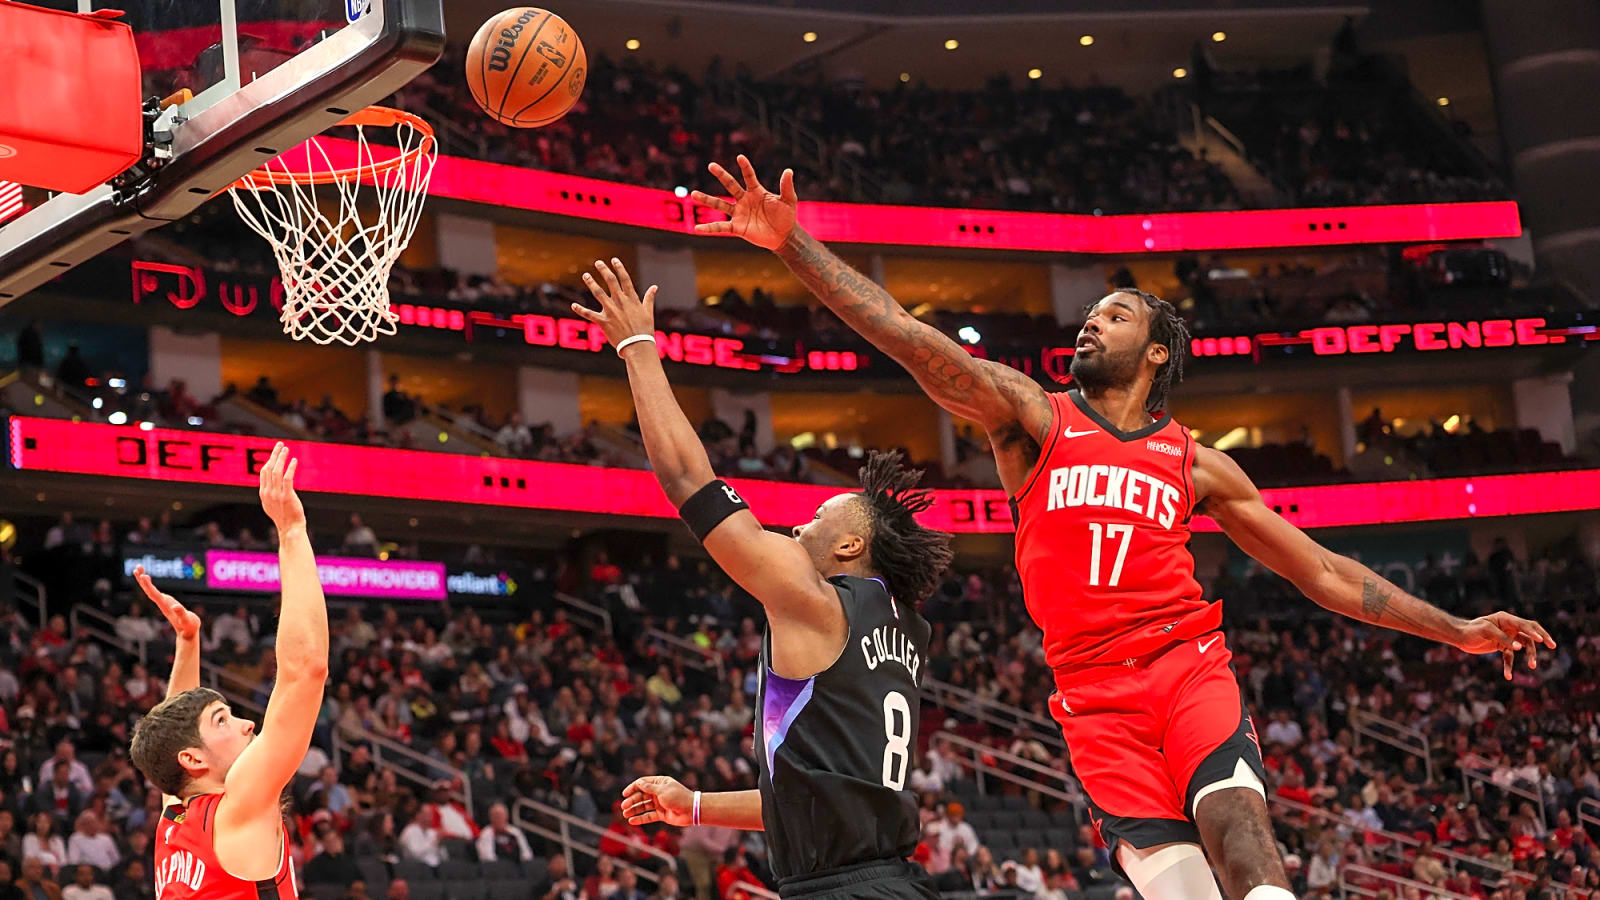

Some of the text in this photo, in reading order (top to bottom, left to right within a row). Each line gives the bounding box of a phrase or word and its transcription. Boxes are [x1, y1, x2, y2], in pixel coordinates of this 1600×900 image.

[488, 9, 541, 72] Wilson
[523, 314, 746, 370] DEFNSE
[1311, 318, 1549, 355] DEFENSE
[1047, 465, 1180, 530] ROCKETS
[213, 558, 281, 583] OFFICIA
[360, 566, 441, 591] PROVIDER
[447, 571, 500, 595] reliant
[1089, 522, 1135, 587] 17
[861, 626, 920, 688] COLLIER
[882, 691, 911, 791] 8
